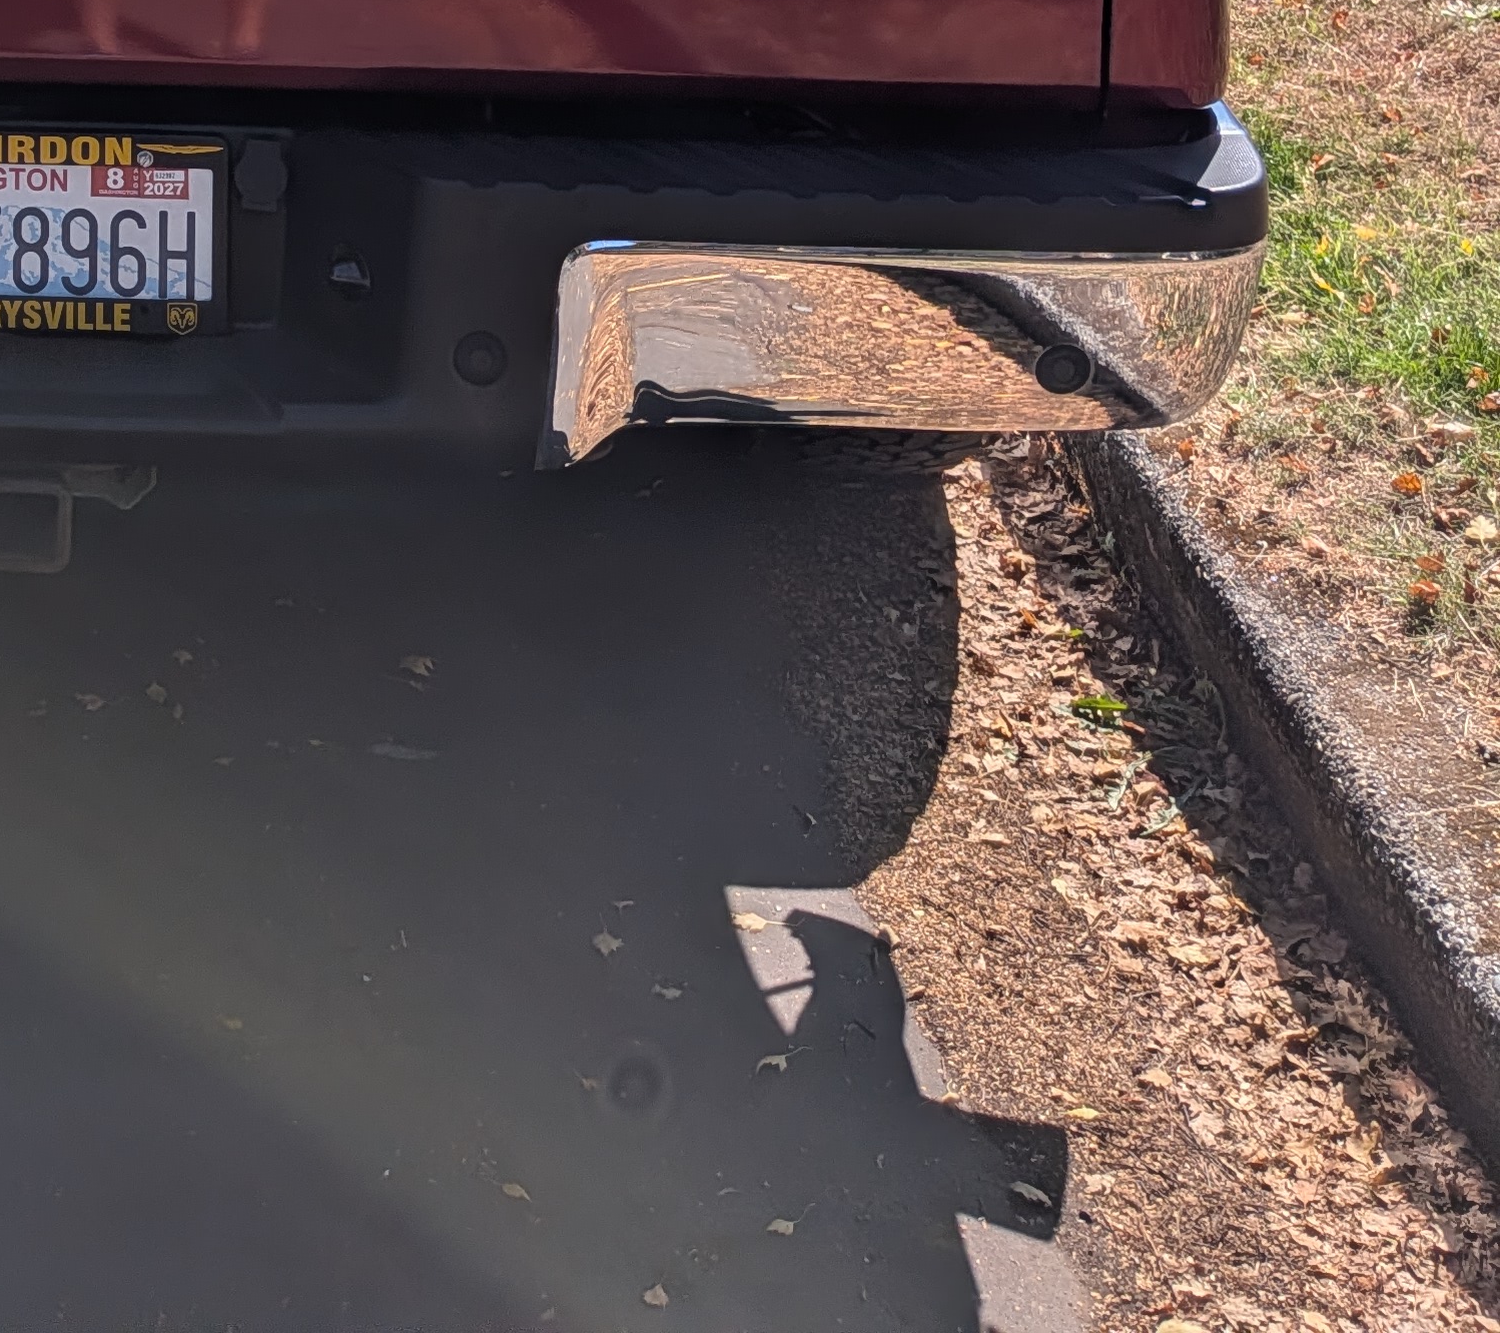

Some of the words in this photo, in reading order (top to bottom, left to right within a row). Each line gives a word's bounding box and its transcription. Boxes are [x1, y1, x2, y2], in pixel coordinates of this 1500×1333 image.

[106, 167, 125, 190] 8
[142, 170, 153, 181] Y
[143, 182, 184, 195] 2027
